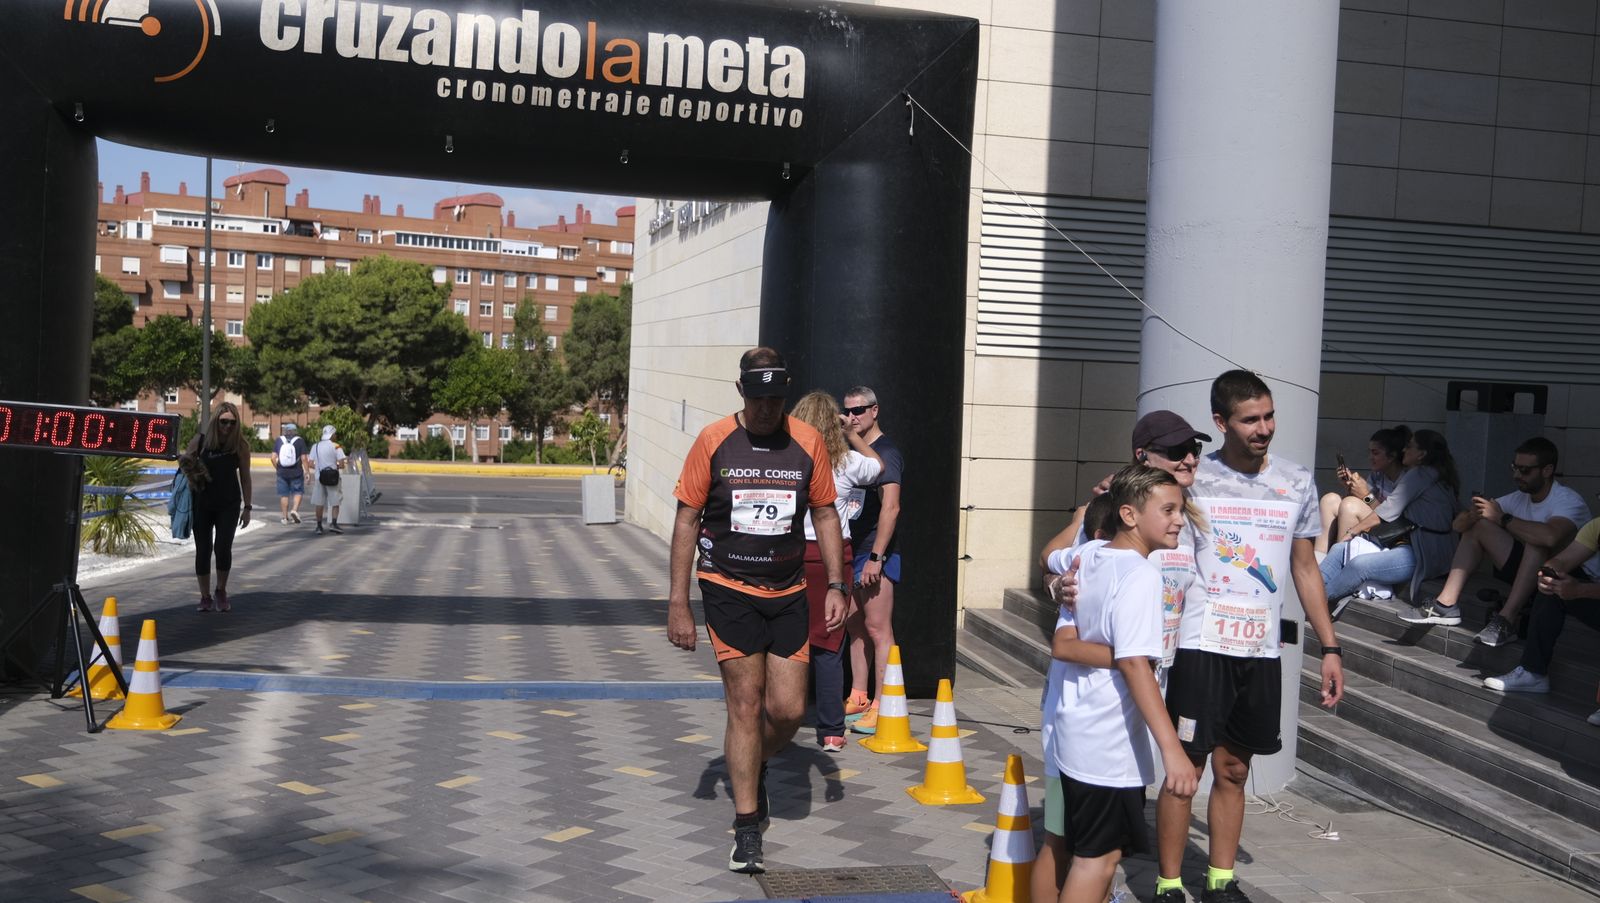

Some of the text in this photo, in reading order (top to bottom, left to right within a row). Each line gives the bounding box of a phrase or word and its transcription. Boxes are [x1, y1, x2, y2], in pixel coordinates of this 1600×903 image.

[436, 77, 804, 128] cronometraje deportivo
[720, 468, 803, 480] GADOR CORRE
[753, 504, 778, 520] 79
[1214, 618, 1266, 640] 1103
